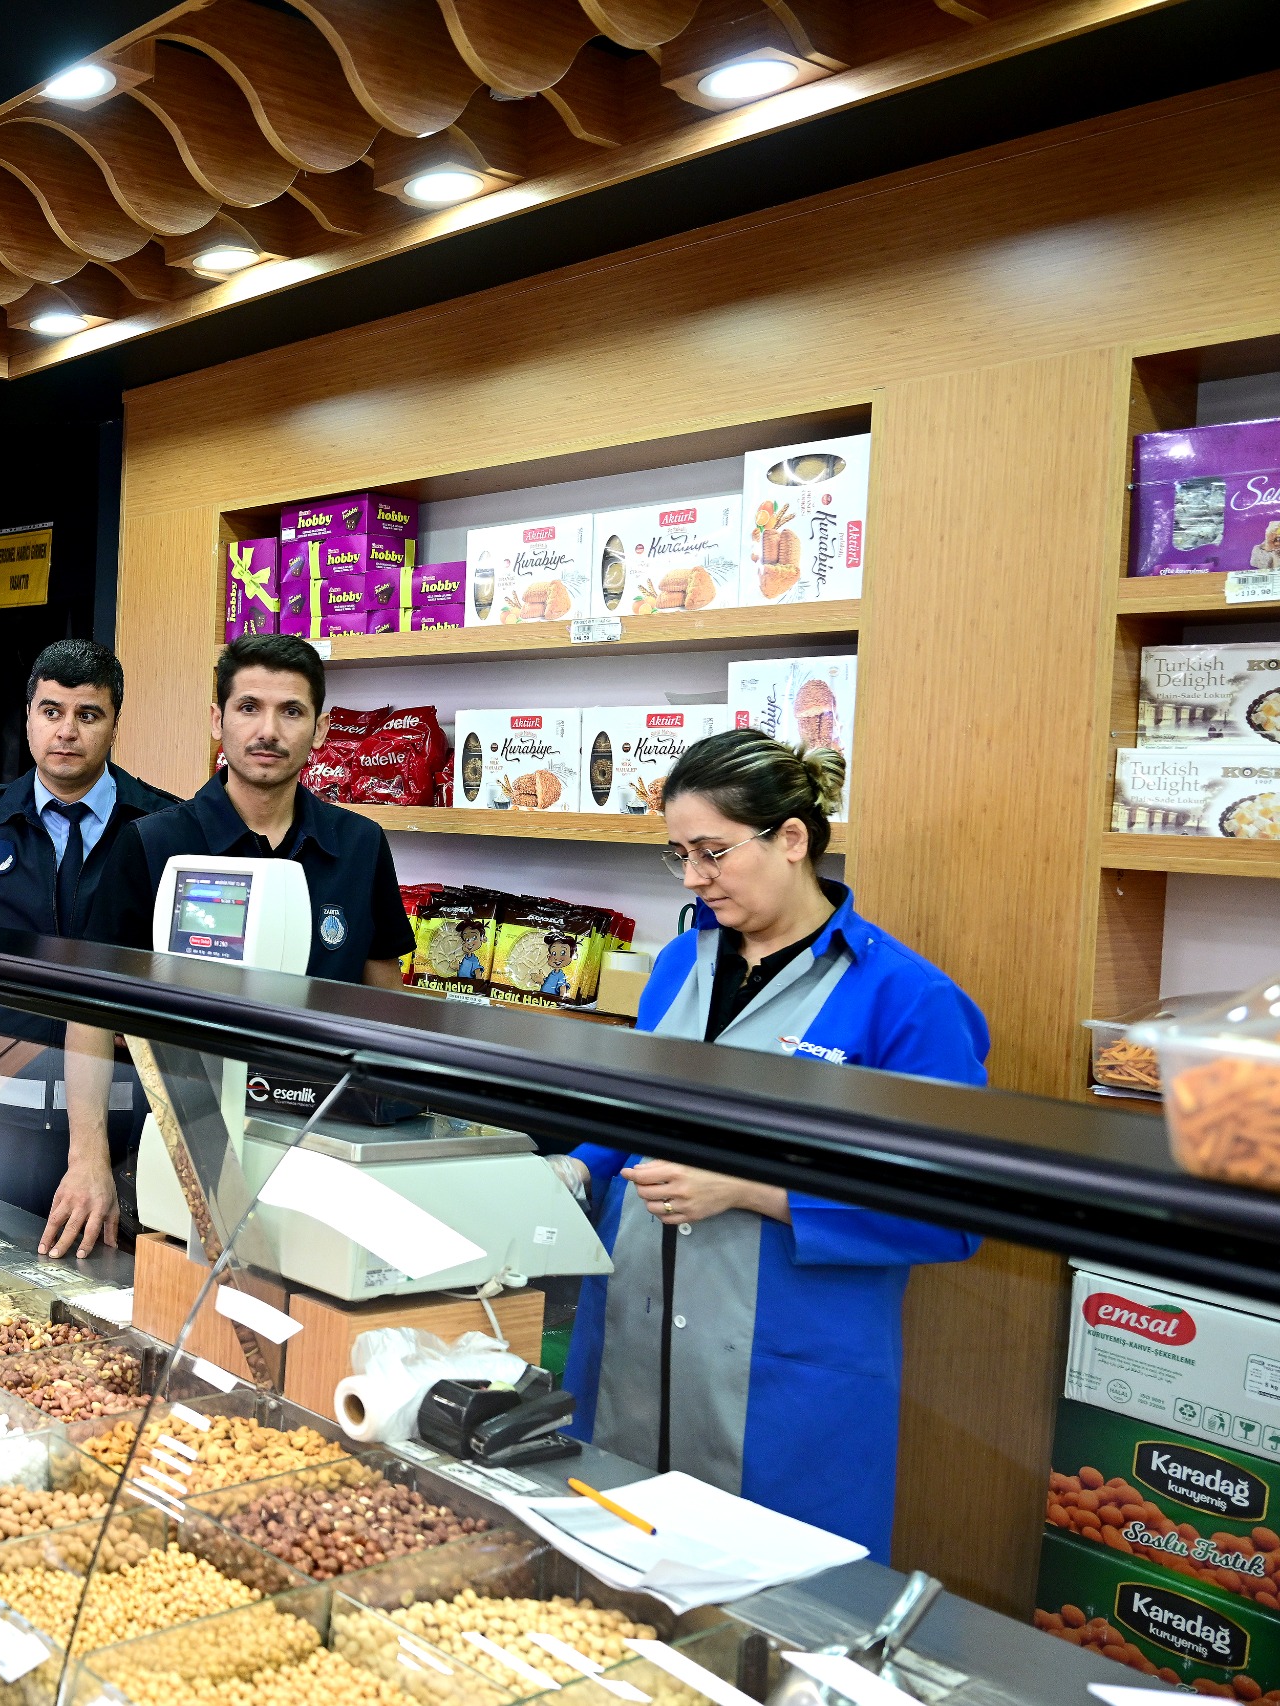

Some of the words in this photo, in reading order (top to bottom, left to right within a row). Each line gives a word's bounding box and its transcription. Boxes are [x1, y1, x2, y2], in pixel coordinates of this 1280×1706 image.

[297, 513, 333, 528] hobby
[377, 508, 410, 524] hobby
[662, 510, 694, 524] Aktürk
[525, 528, 554, 541] Aktürk
[848, 524, 860, 564] Aktürk
[326, 552, 360, 566] hobby
[370, 549, 404, 563] hobby
[810, 510, 837, 598] Kurabiye
[513, 551, 574, 576] Kurabiye
[420, 580, 460, 593] hobby
[230, 580, 238, 622] hobby
[328, 590, 363, 604] hobby
[1155, 656, 1224, 672] Turkish
[1156, 672, 1226, 691] Delight
[512, 718, 540, 728] Aktürk
[648, 716, 682, 726] Aktürk
[500, 738, 560, 762] Kurabiye
[634, 737, 690, 764] Kurabi
[360, 752, 405, 767] tadelle
[1130, 761, 1199, 776] Turkish
[1131, 776, 1200, 796] Delight
[445, 982, 473, 994] Helva
[523, 995, 557, 1008] Helva
[798, 1042, 847, 1065] esenlik
[273, 1088, 316, 1103] esenlik
[1097, 1304, 1180, 1338] emsal
[1087, 1329, 1196, 1366] KURUYEMİŞ-KAHVE-ŞEKERLEME
[1151, 1451, 1250, 1507] Karadağ
[1168, 1480, 1227, 1512] kuruyemiş
[1123, 1521, 1188, 1557] Soslu
[1191, 1538, 1265, 1577] Fıstık
[1132, 1593, 1231, 1655] Karadağ
[1149, 1623, 1208, 1658] kuruyemiş
